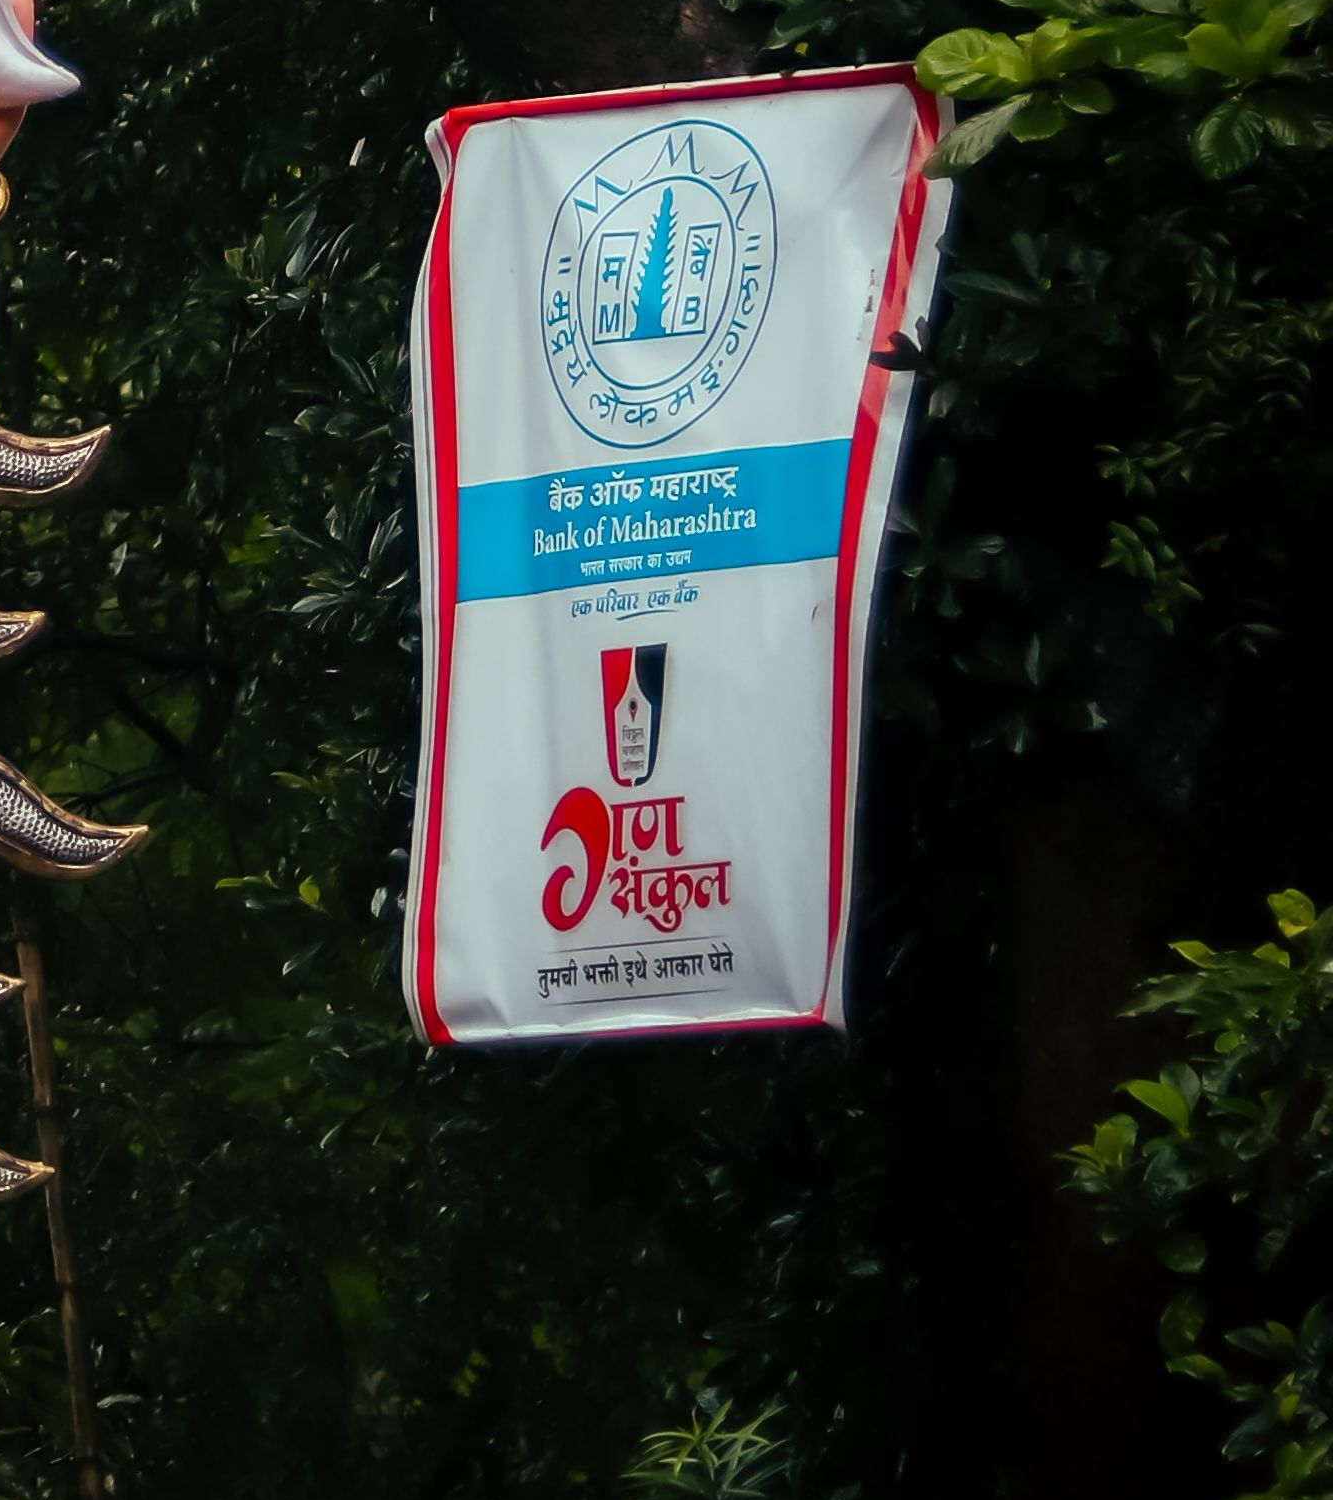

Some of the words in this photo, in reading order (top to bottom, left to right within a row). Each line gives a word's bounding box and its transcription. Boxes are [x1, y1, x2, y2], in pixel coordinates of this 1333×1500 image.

[602, 256, 626, 290] म
[598, 302, 621, 334] M
[682, 296, 701, 325] B
[548, 477, 584, 512] बैंक
[590, 470, 644, 507] ऑफ
[650, 466, 739, 501] महाराष्ट्र
[533, 521, 580, 556] Bank
[584, 516, 607, 548] of
[610, 503, 757, 544] Maharashtra
[580, 559, 605, 577] भारत
[609, 555, 643, 573] सरकार
[647, 553, 662, 569] का
[571, 599, 593, 618] एक
[596, 588, 640, 615] परिवार
[647, 590, 673, 609] एक
[540, 786, 685, 932] गण
[607, 855, 732, 933] संकुल
[537, 959, 579, 999] तुमची
[583, 954, 619, 985] भक्ती
[622, 951, 648, 987] इथे
[653, 954, 705, 979] आकार
[707, 942, 734, 973] घेते
